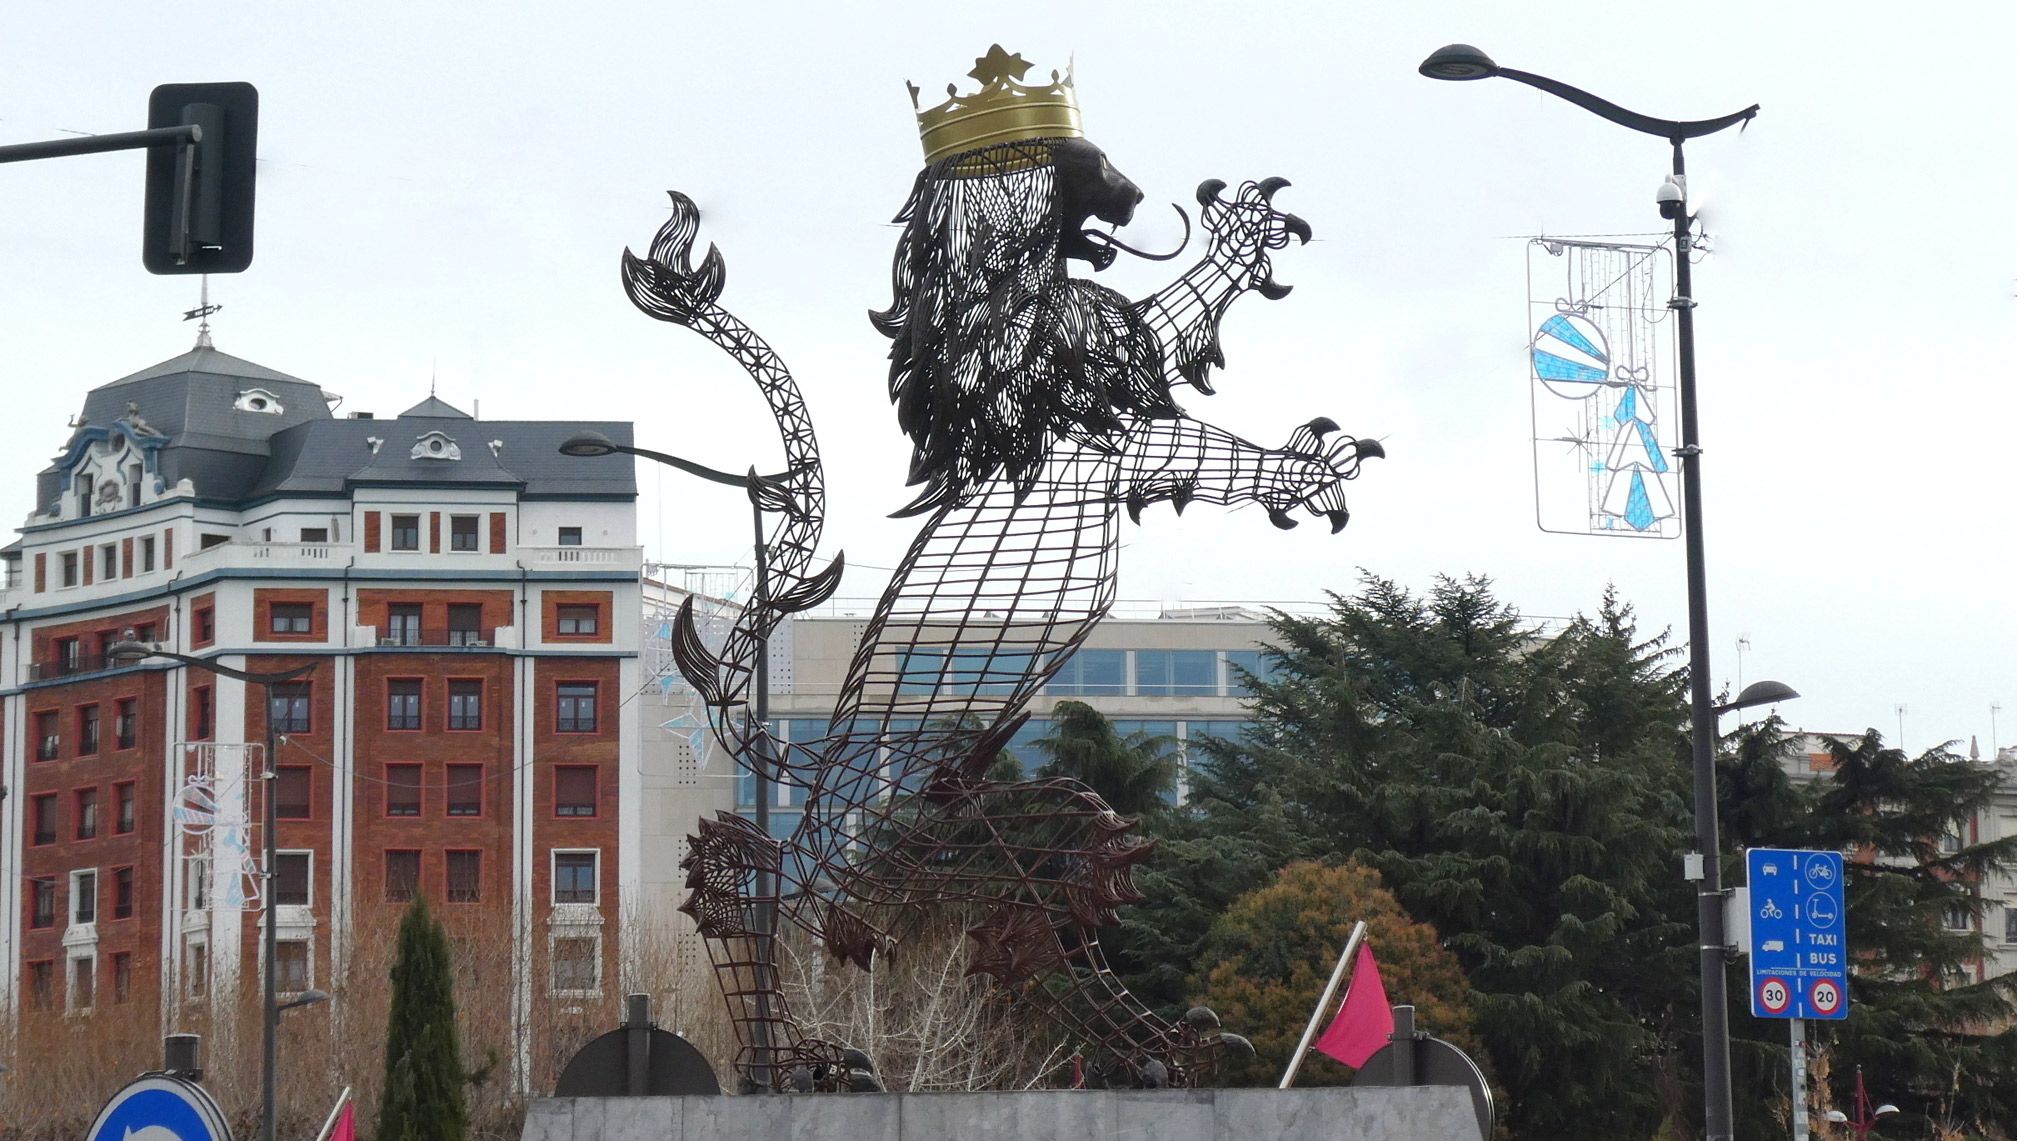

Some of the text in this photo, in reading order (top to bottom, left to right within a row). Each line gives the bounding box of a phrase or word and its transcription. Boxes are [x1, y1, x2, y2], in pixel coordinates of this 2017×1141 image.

[1809, 934, 1837, 945] TAXI
[1810, 953, 1837, 964] BUS
[1766, 989, 1783, 1002] 30
[1817, 991, 1834, 1003] 20
